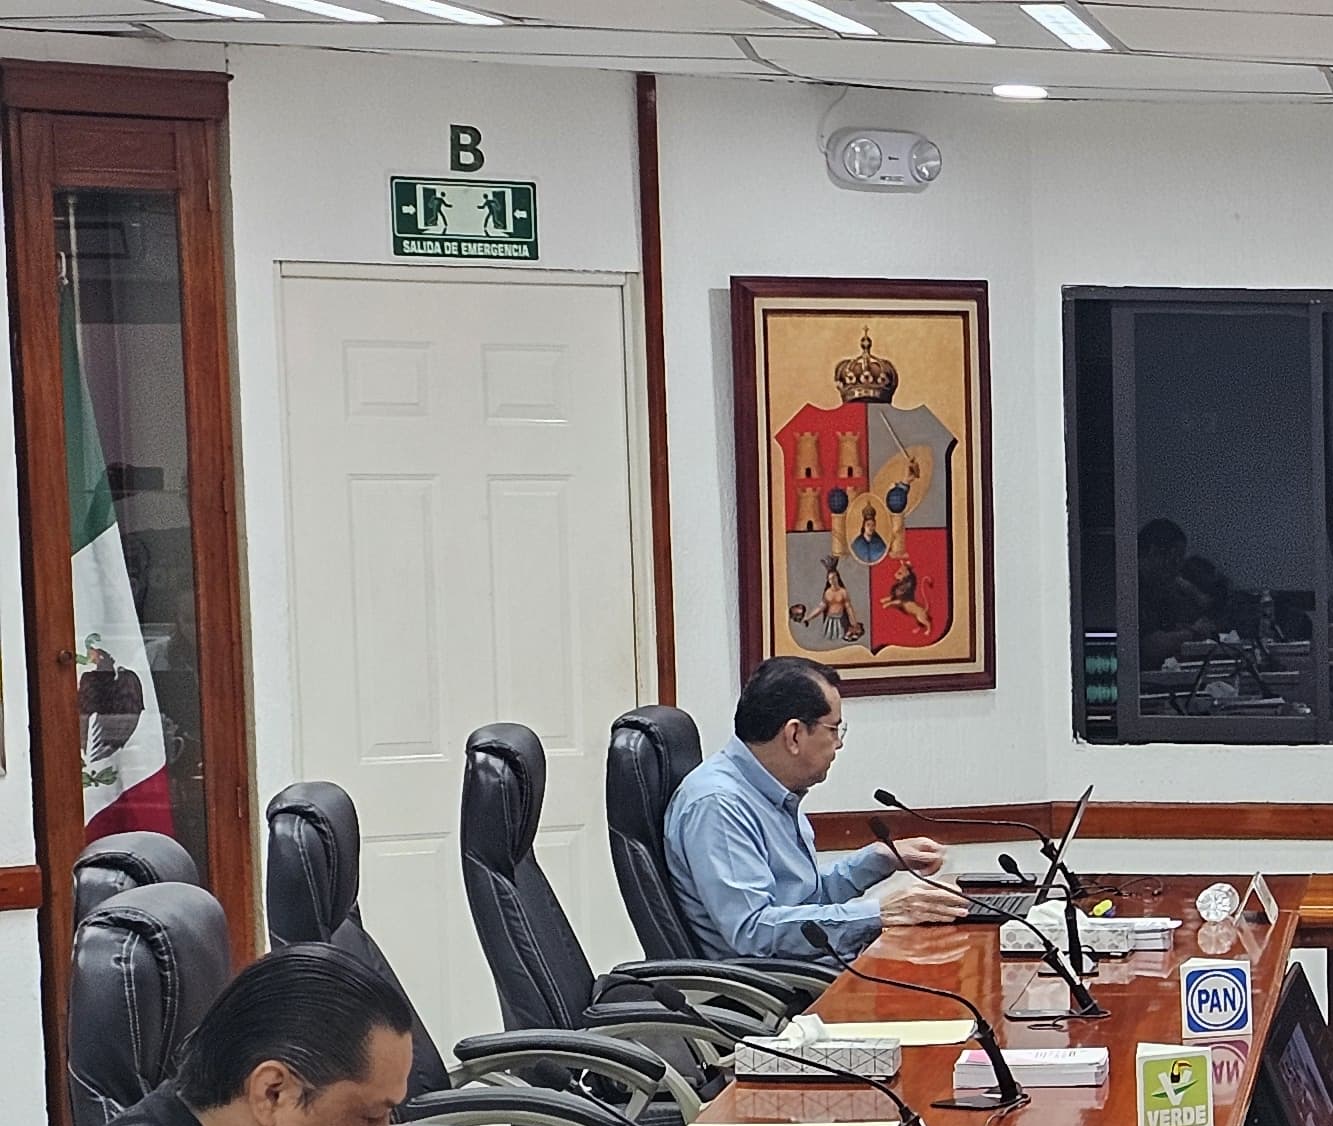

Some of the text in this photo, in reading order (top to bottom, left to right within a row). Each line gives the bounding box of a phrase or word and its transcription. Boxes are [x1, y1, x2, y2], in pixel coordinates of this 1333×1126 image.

[449, 124, 485, 173] B
[402, 239, 531, 258] SALIDA DE EMERGENCIA
[1197, 986, 1237, 1014] PAN
